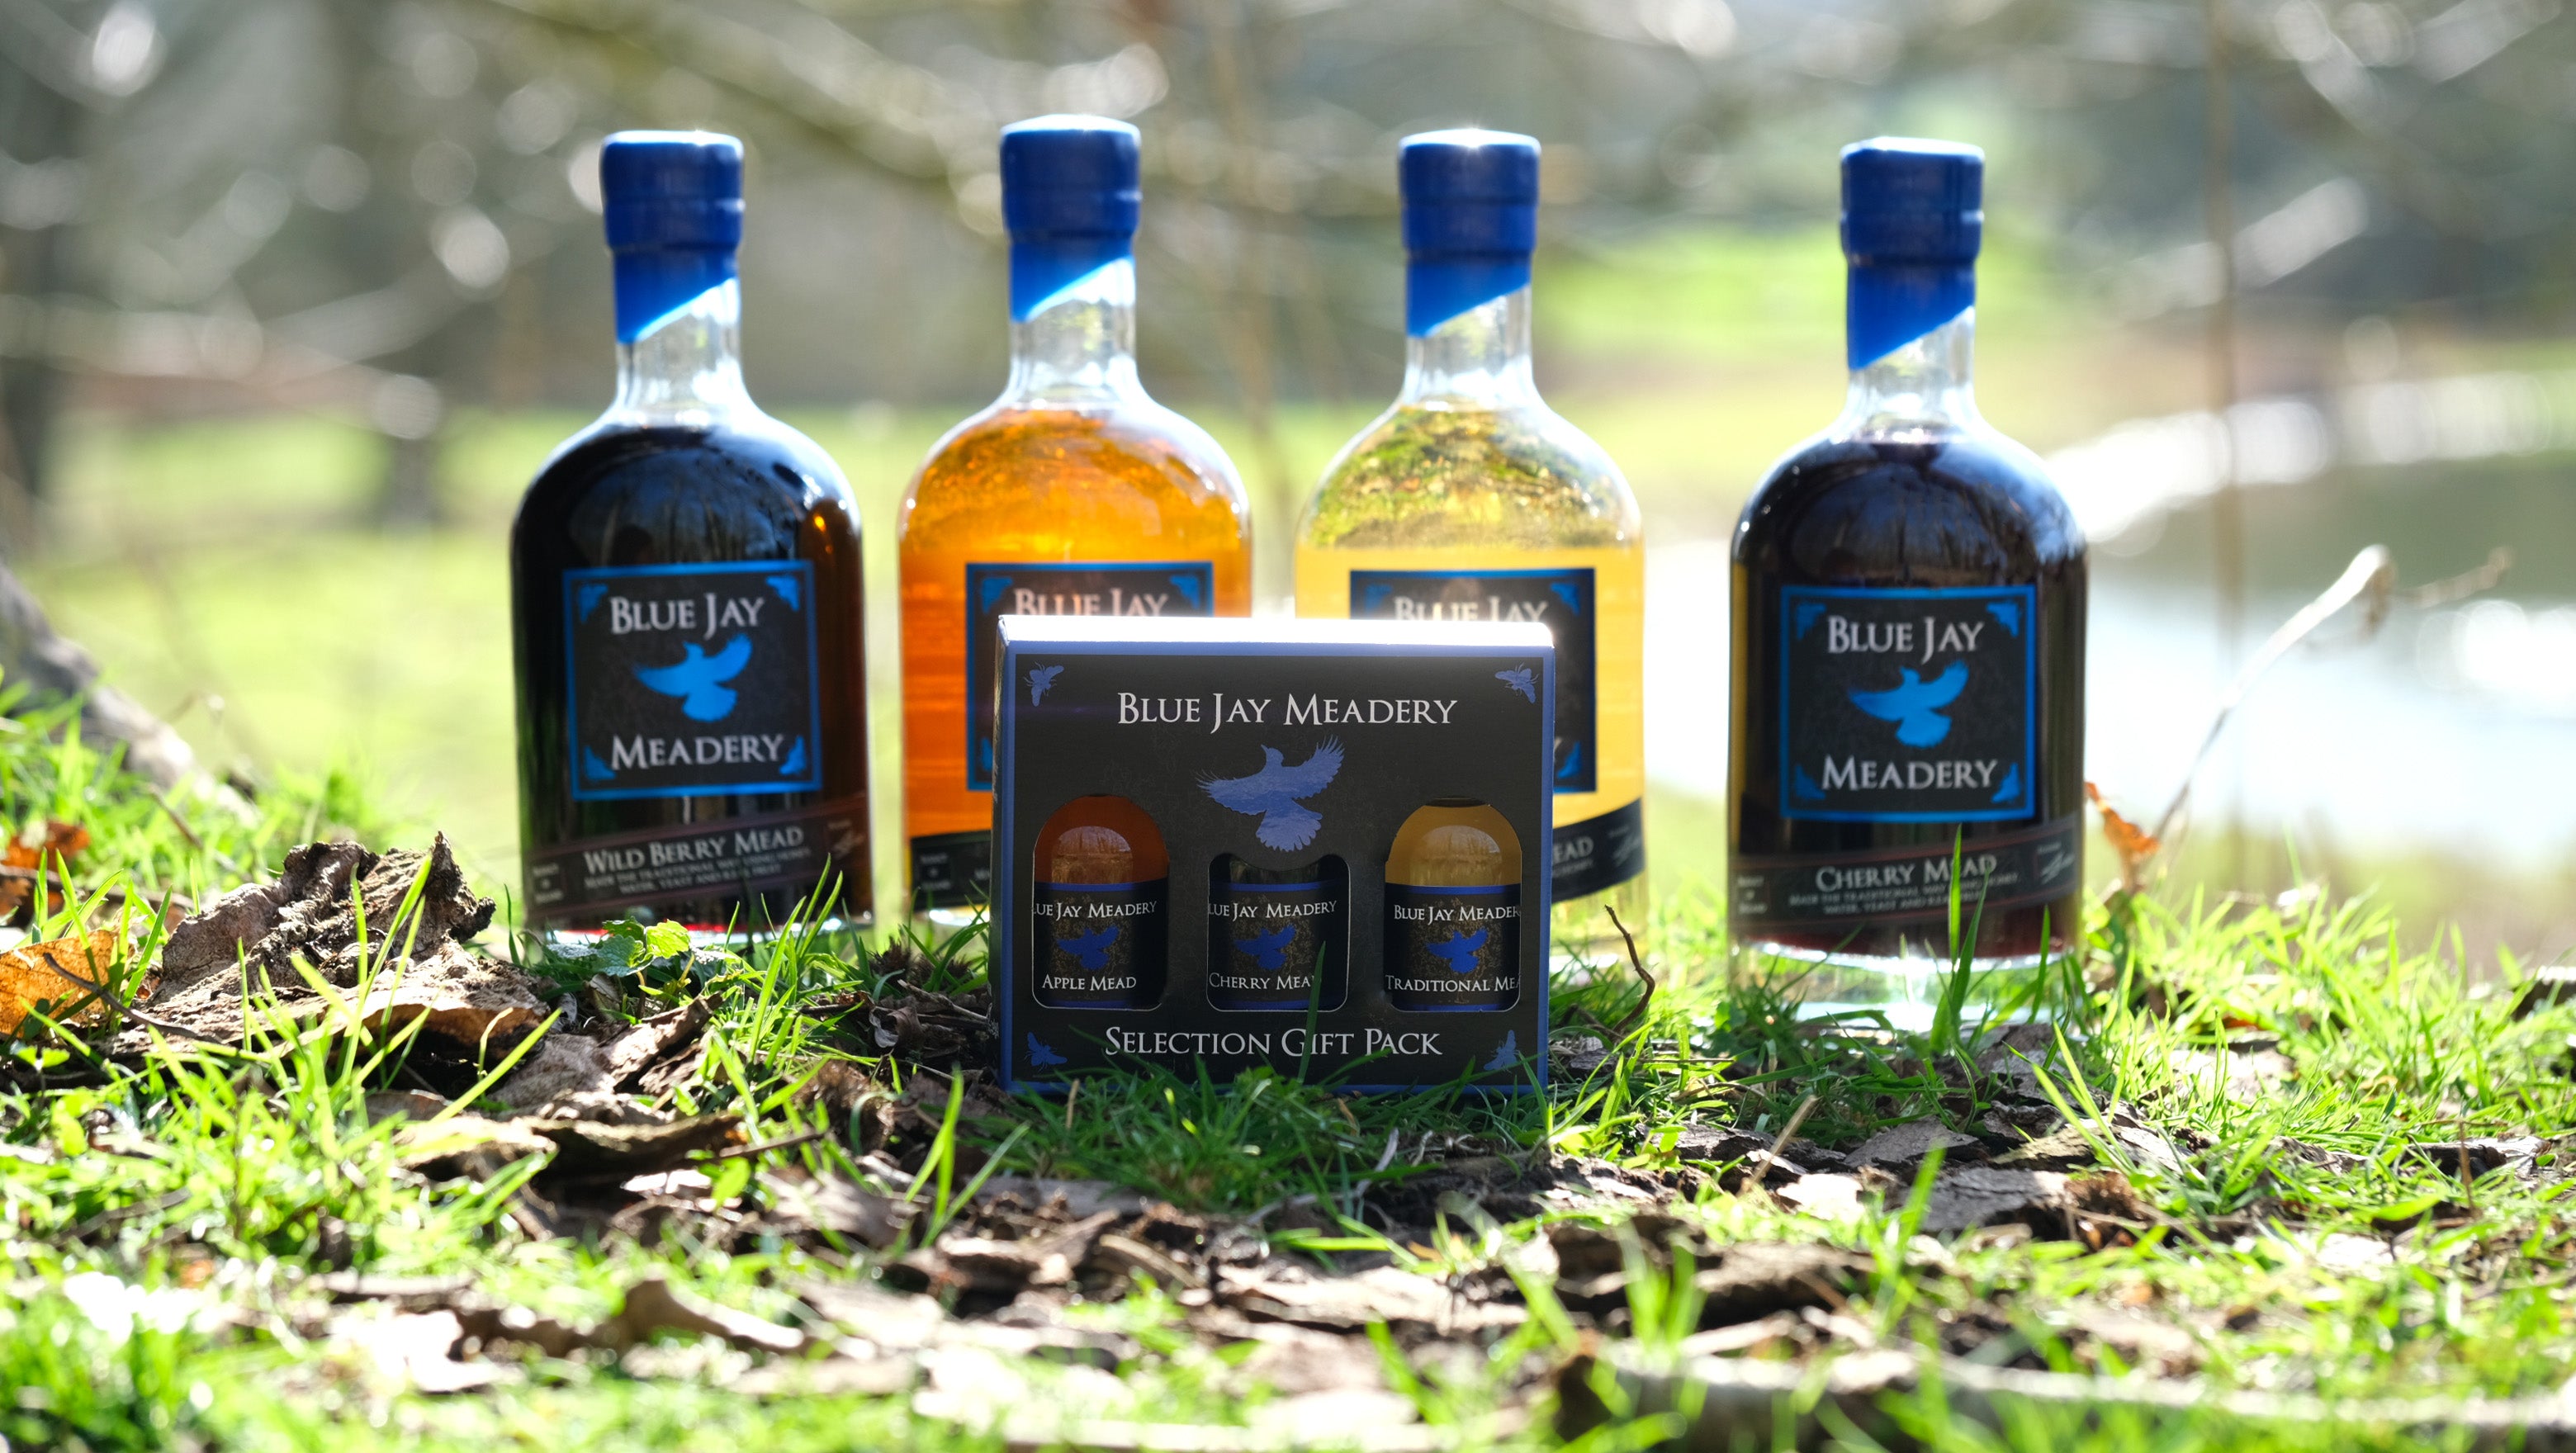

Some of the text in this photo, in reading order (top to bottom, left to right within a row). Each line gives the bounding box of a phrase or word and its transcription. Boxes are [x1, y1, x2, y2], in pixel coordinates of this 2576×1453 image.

[610, 593, 765, 640] BLUE JAY
[1827, 614, 1985, 665] BLUE JAY
[1117, 692, 1458, 734] BLUE JAY MEADERY
[611, 733, 784, 770] MEADERY
[1821, 754, 1997, 792] MEADERY
[583, 848, 646, 875] WILD
[648, 835, 727, 868] BERRY
[734, 826, 805, 856] MEAD
[1552, 836, 1594, 864] EAD
[1816, 864, 1915, 892] CHERRY
[1923, 854, 1997, 884] MAD
[1056, 902, 1082, 921] JAY
[1087, 901, 1157, 918] MEADERY
[1209, 900, 1338, 922] LUE JAY MEADERY
[1394, 905, 1521, 925] BLUE JAY MEADER
[1042, 973, 1137, 991] APPLE MEAD
[1209, 973, 1321, 990] CHERRY MEA
[1385, 975, 1490, 992] TRADITIONAL
[1105, 1026, 1442, 1057] SELECTION GIFT PACK
